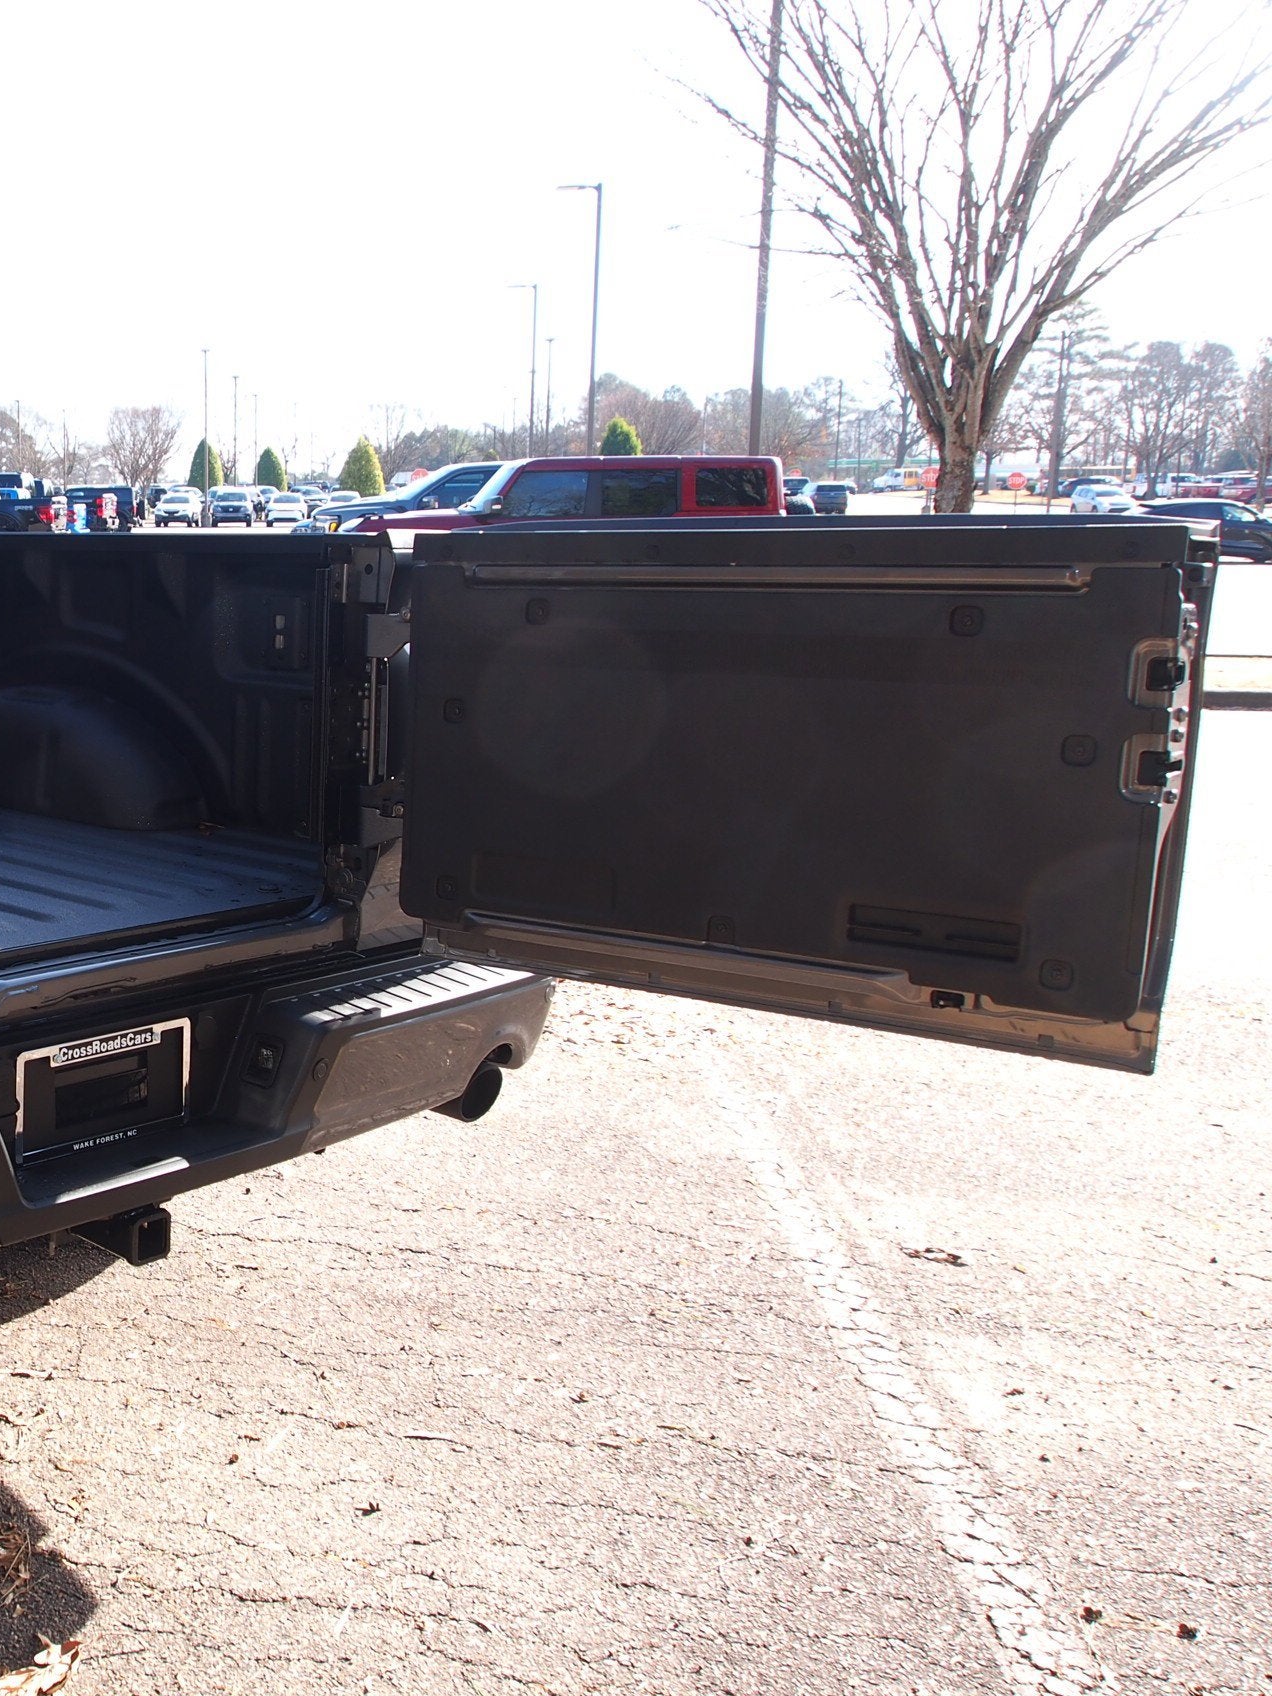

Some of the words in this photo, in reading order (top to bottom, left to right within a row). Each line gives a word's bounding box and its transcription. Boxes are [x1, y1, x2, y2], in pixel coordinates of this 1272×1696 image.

[1008, 476, 1025, 485] STOP
[60, 1031, 152, 1061] CrossRoadsCars
[73, 1140, 94, 1151] WAKE
[96, 1132, 126, 1144] FOREST,
[128, 1129, 138, 1137] NC
